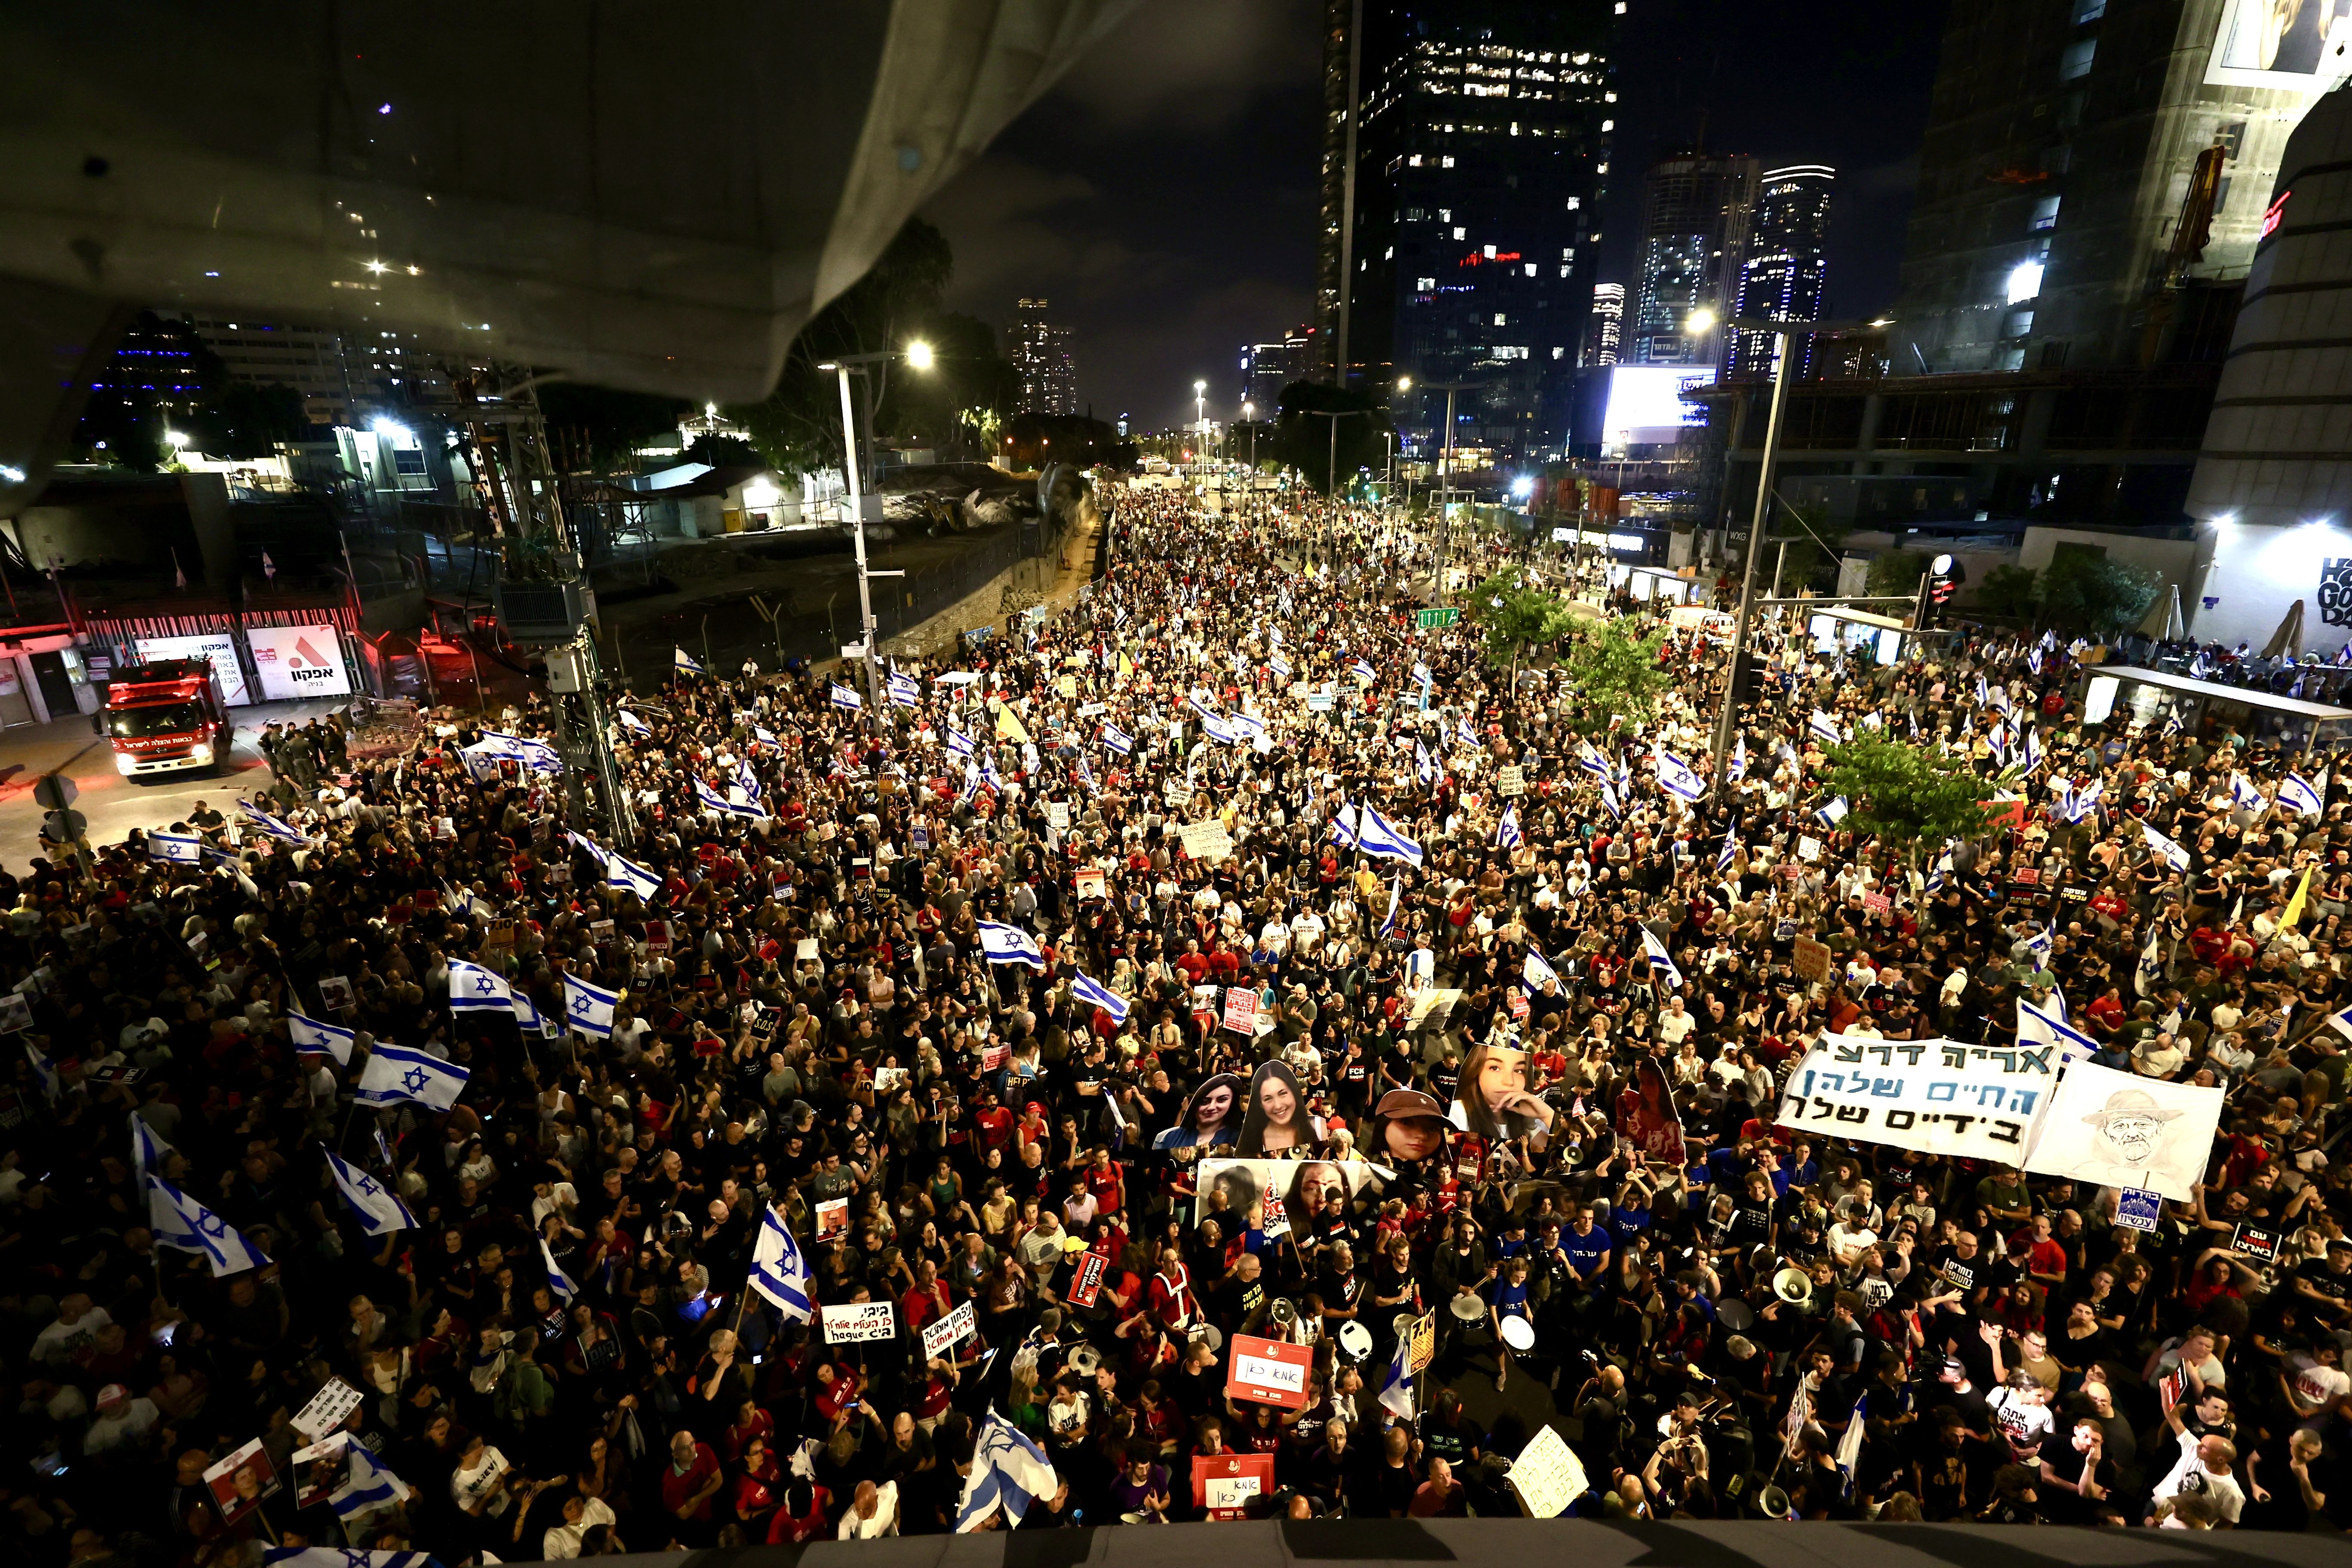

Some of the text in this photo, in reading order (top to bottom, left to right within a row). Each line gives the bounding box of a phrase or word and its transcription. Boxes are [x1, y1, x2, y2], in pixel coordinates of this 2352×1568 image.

[1730, 531, 1747, 541] WXG
[202, 643, 229, 651] אפקון
[291, 668, 334, 682] אפקון
[124, 740, 149, 749] לישראל
[2061, 892, 2087, 902] עכשיו!
[489, 919, 513, 932] 7.10
[754, 1018, 773, 1031] S.O.S
[1291, 1055, 1309, 1064] ATLANT
[1942, 1045, 2052, 1074] אריה
[858, 1082, 872, 1092] .10
[1804, 1068, 2040, 1115] החיים שלהן
[1788, 1093, 1870, 1123] שלך
[2123, 1187, 2159, 1201] בחירות
[2249, 1230, 2267, 1239] עם
[2236, 1240, 2272, 1257] בארצו
[1949, 1261, 1974, 1279] בוחרים
[1946, 1268, 1974, 1287] בחטופי
[1243, 1283, 1262, 1299] הדחה
[1243, 1292, 1264, 1311] עכשיו
[861, 1306, 888, 1318] ביבי,
[835, 1320, 850, 1329] שולח
[853, 1320, 878, 1329] העולם
[1412, 1313, 1434, 1340] 7.10
[832, 1329, 864, 1341] hague
[1246, 1362, 1298, 1384] אמא כאן
[2003, 1407, 2026, 1422] אתה
[2000, 1414, 2028, 1433] הראש
